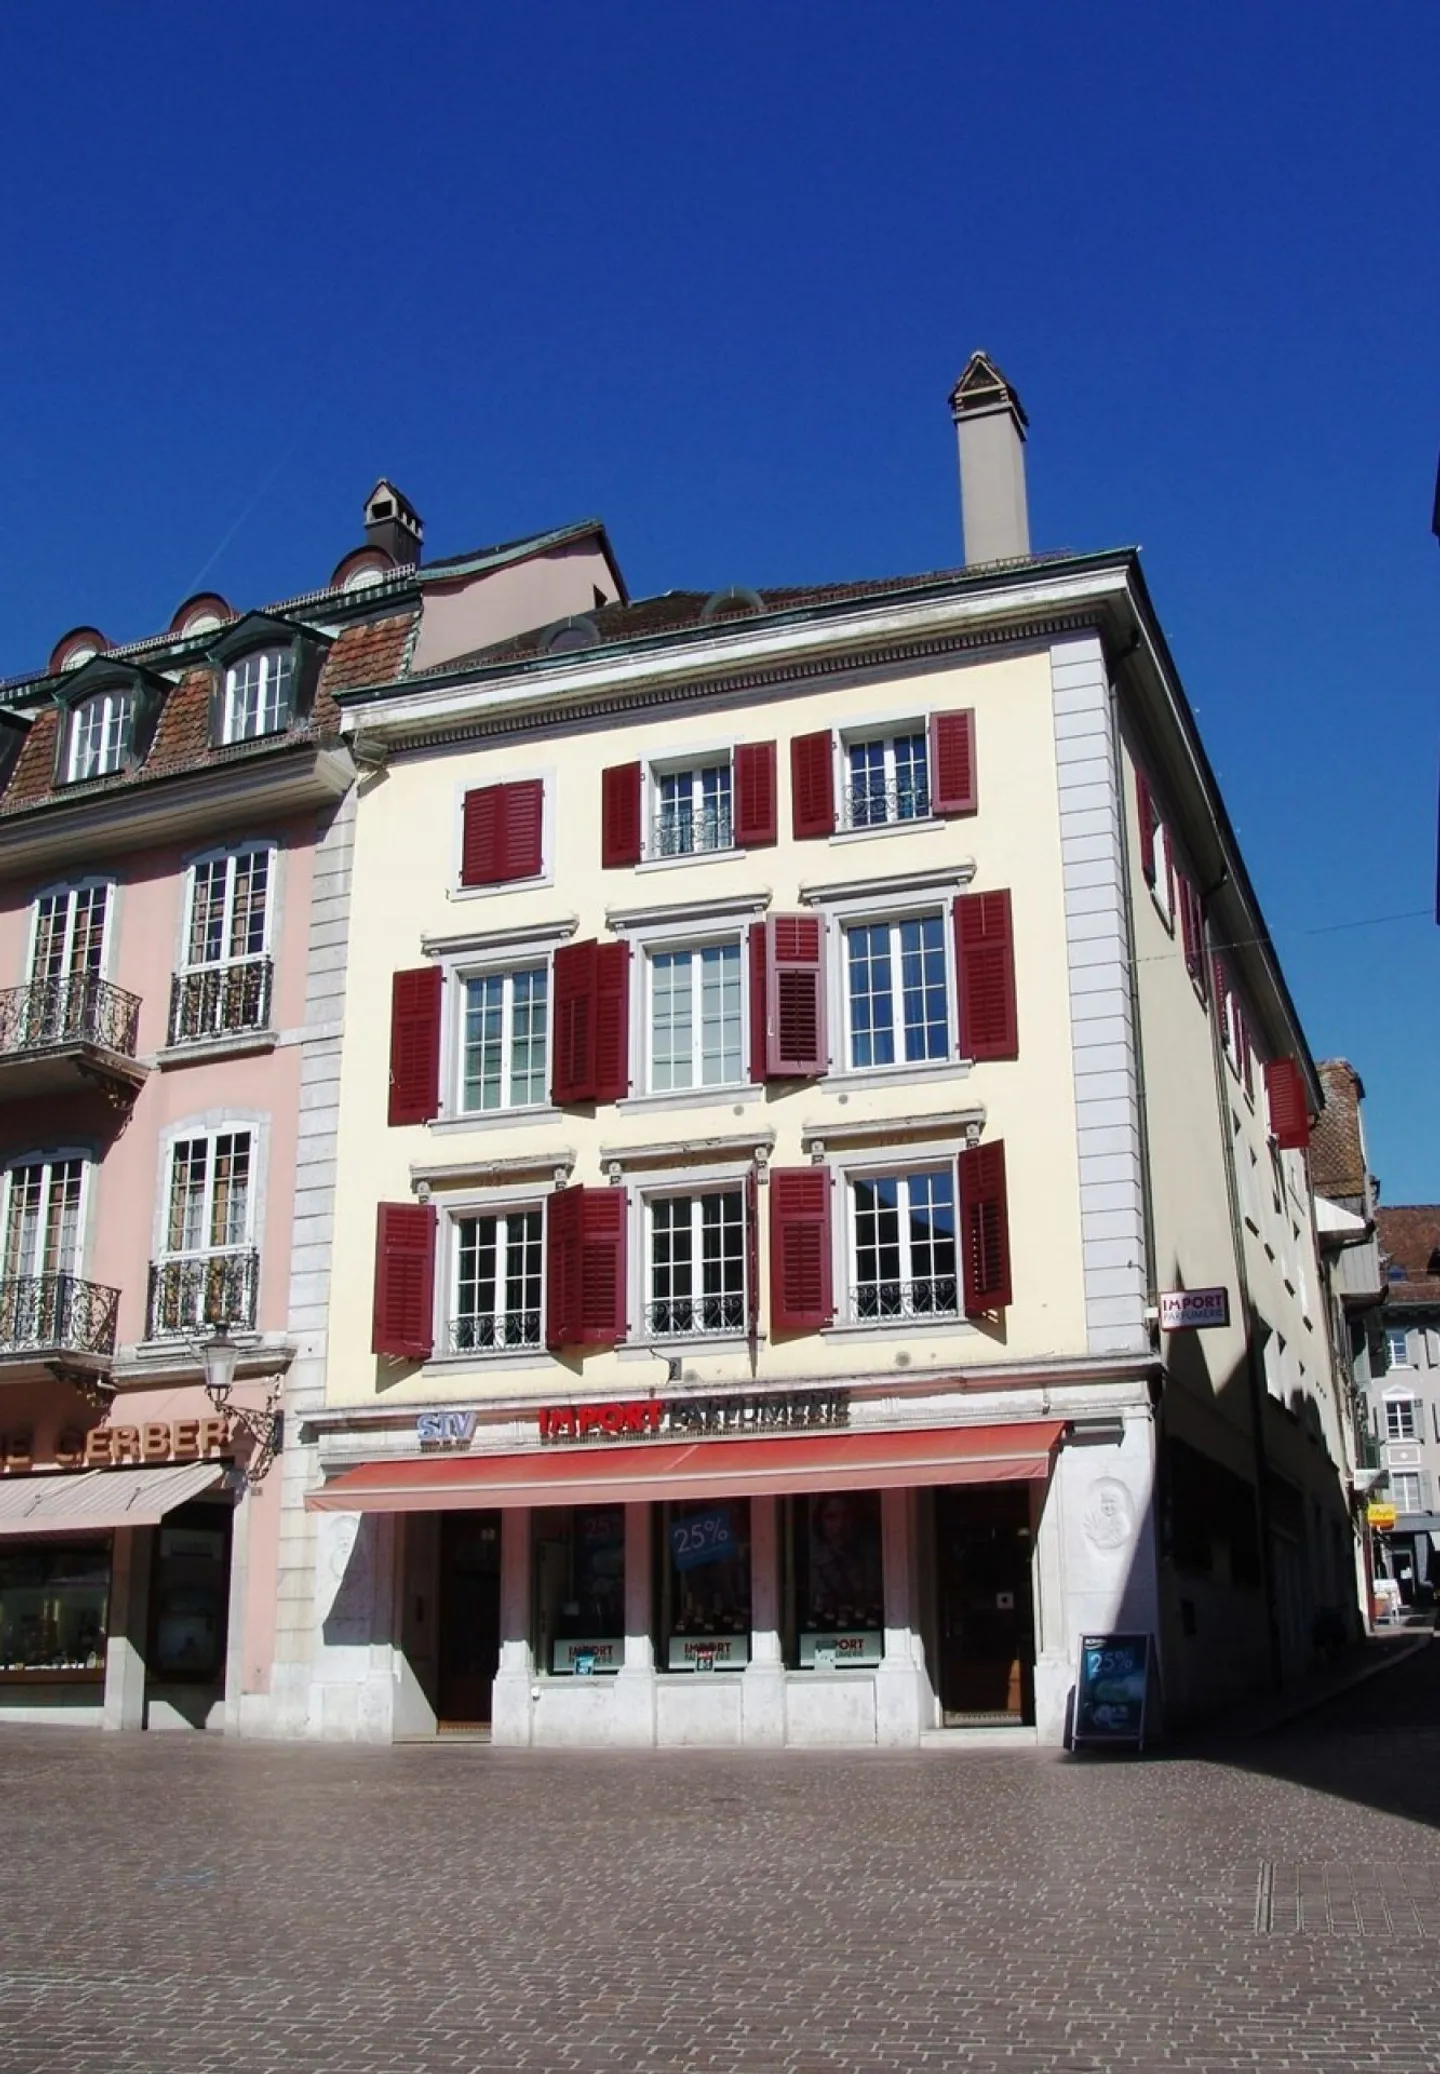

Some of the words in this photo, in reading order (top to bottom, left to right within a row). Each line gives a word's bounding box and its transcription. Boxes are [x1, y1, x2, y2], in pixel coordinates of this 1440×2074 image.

[1163, 1295, 1222, 1311] IMPORT
[538, 1398, 663, 1436] IMPORT
[674, 1517, 728, 1553] 25%
[568, 1645, 613, 1657] IMORT
[684, 1642, 732, 1654] IMRT
[1090, 1651, 1133, 1673] 25%
